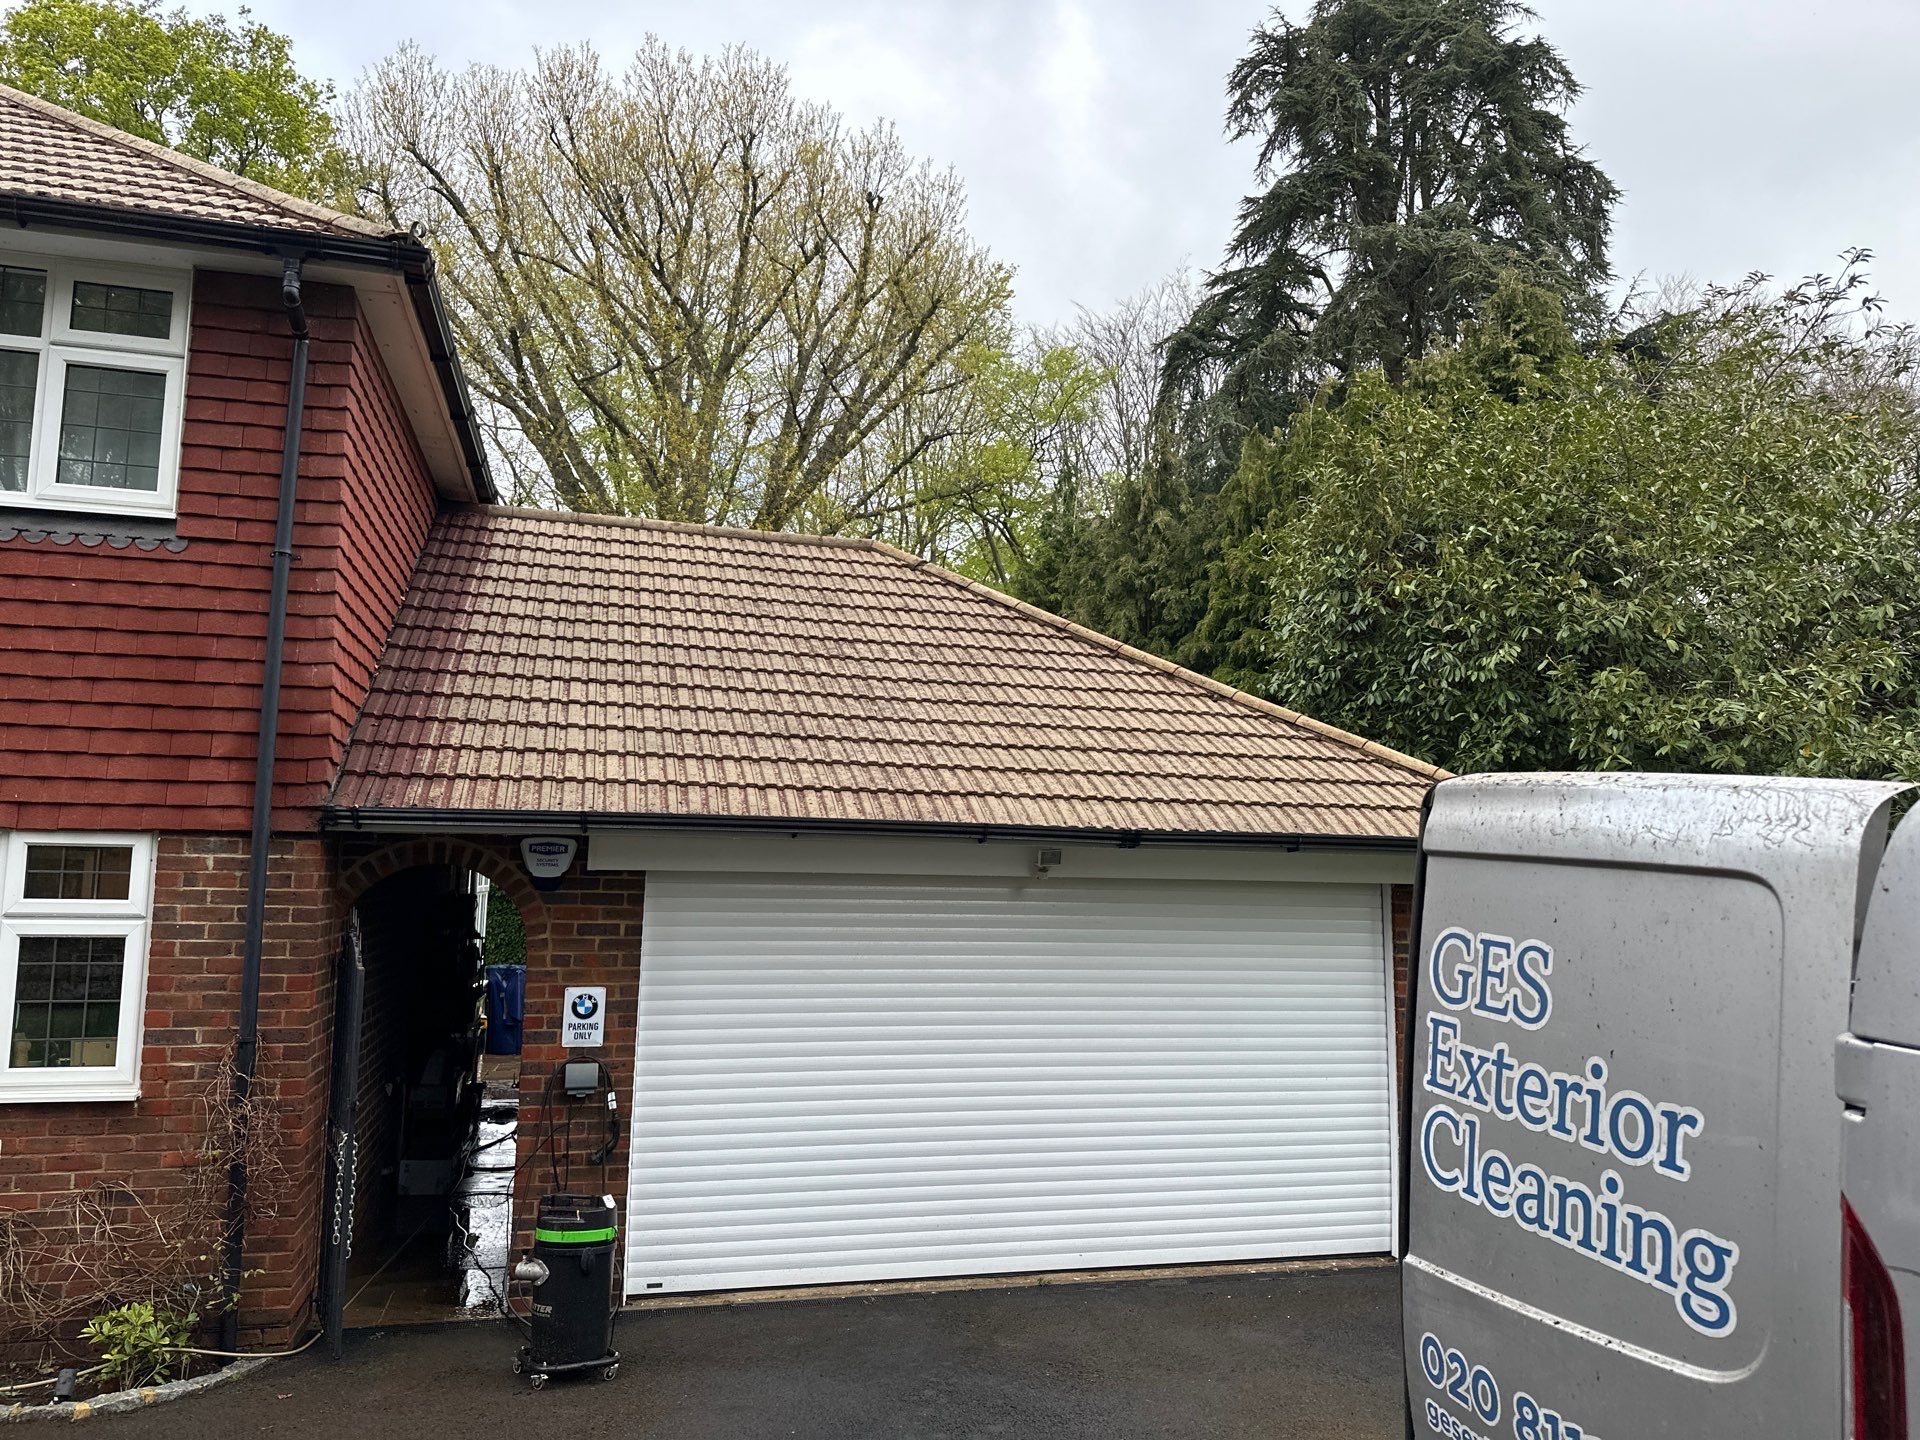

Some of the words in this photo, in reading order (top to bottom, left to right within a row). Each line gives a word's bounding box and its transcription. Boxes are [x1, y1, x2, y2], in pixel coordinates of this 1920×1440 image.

[1429, 926, 1554, 1031] GES
[573, 1032, 592, 1040] ONLY
[1425, 1011, 1704, 1182] Exterior
[1421, 1104, 1740, 1339] Cleaning
[1420, 1332, 1501, 1427] 020
